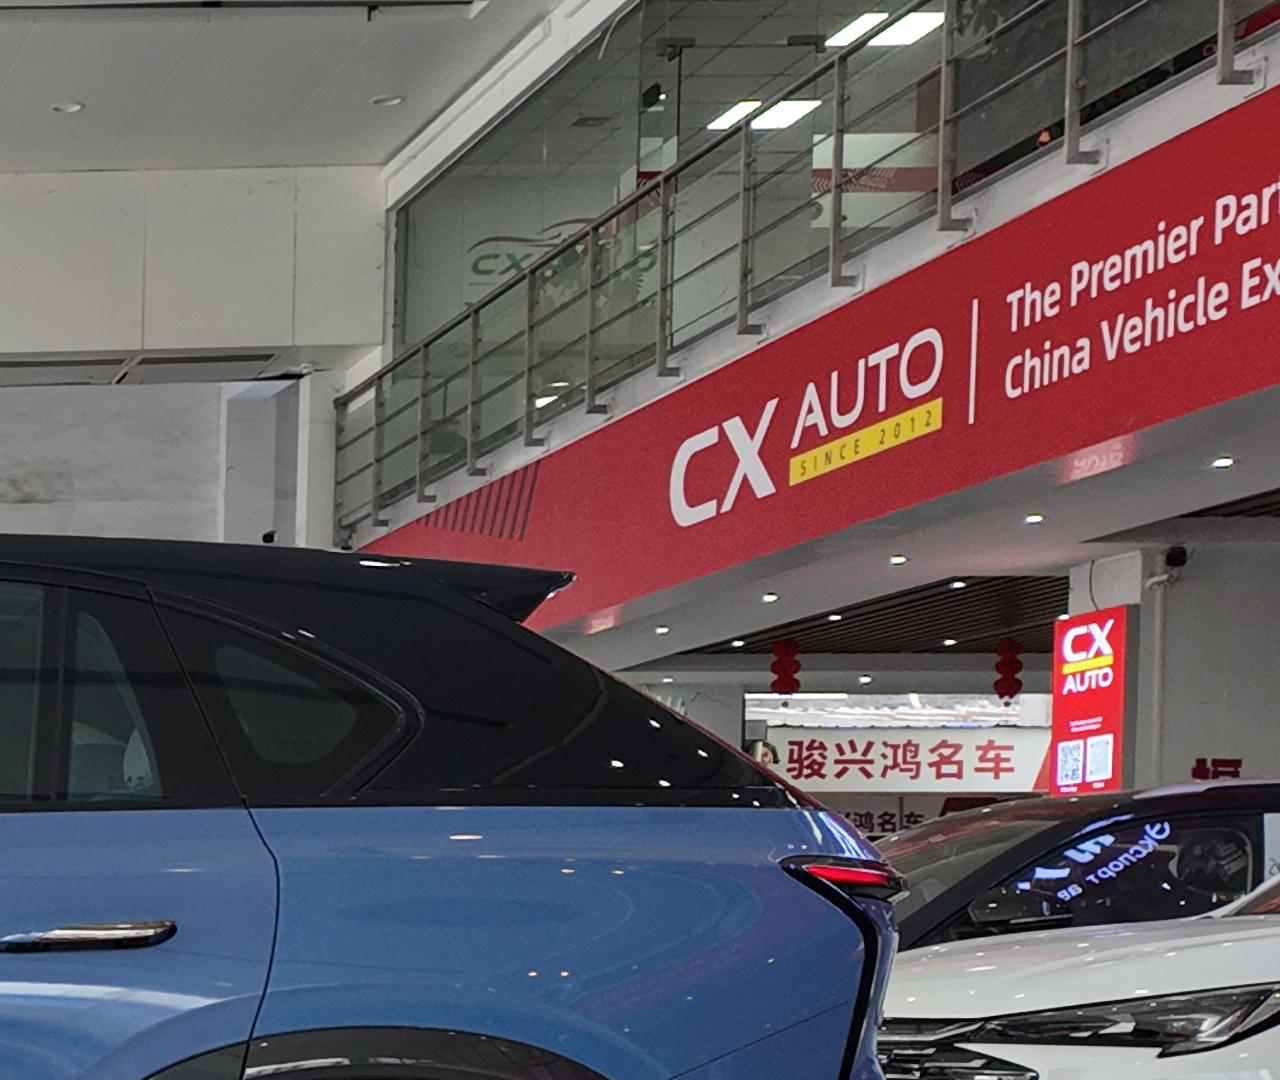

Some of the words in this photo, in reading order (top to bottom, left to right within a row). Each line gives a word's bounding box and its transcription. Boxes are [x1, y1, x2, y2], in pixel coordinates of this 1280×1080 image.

[1006, 281, 1061, 333] The
[1070, 215, 1204, 307] Premier
[1214, 173, 1280, 245] Par
[1005, 337, 1091, 399] China
[1100, 276, 1230, 361] Vehicle
[669, 397, 779, 527] CX
[790, 328, 943, 450] AUTO
[800, 439, 861, 477] SINCE
[878, 410, 933, 445] 2012
[1062, 618, 1115, 663] CX
[1062, 666, 1114, 696] AUTO
[785, 738, 1015, 780] 骏兴鸿名车
